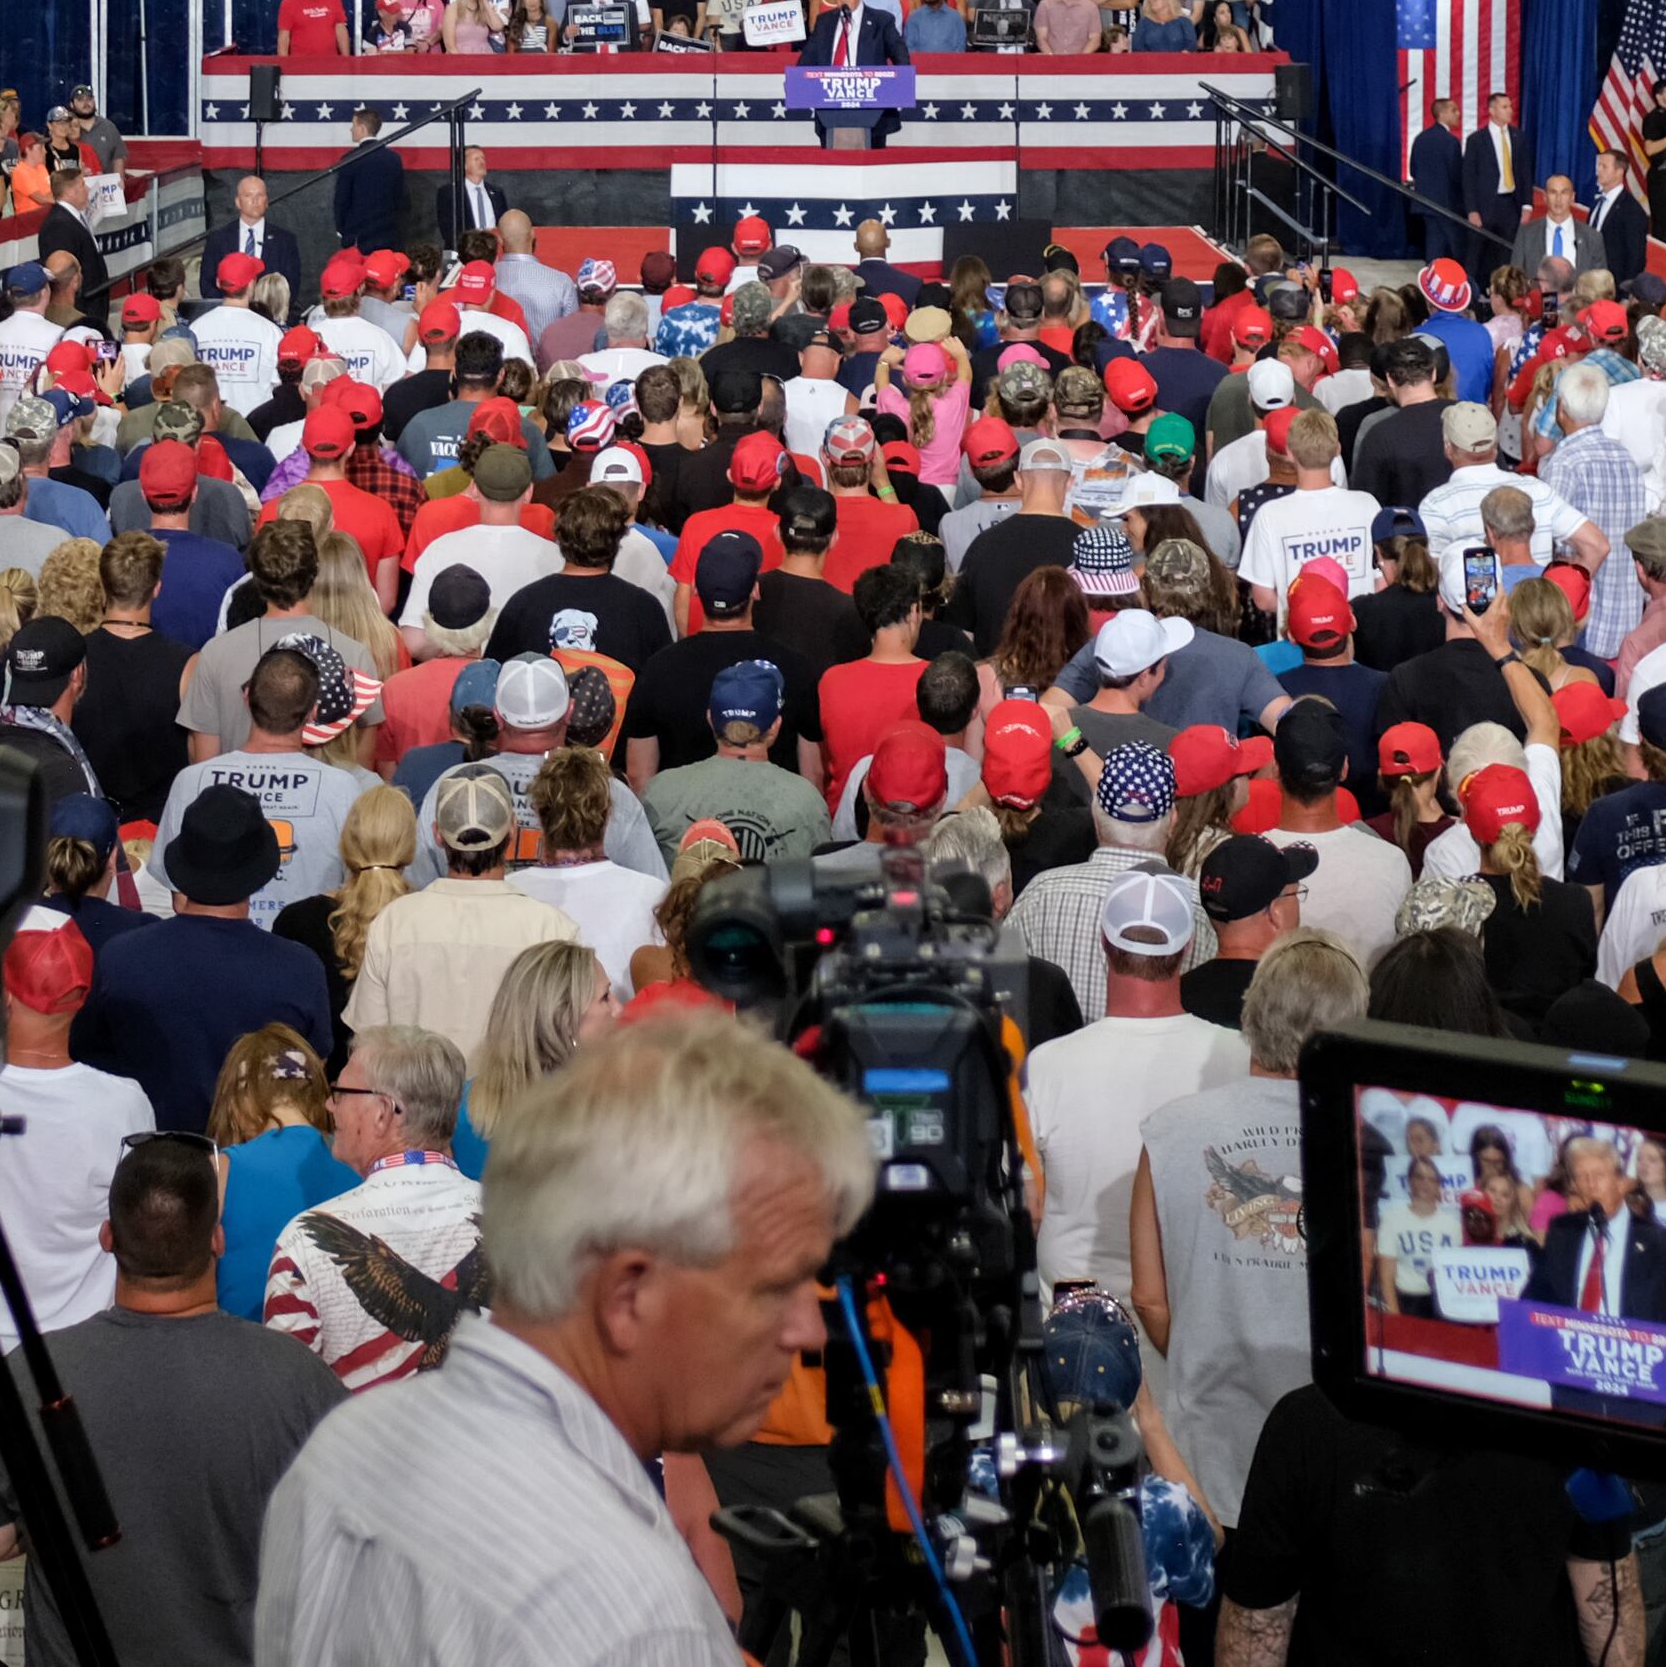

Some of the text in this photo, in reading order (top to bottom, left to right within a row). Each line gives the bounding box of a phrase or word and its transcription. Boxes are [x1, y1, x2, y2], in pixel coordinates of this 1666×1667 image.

[574, 14, 603, 25] BACK
[748, 9, 798, 25] TRUMP
[595, 24, 625, 35] BLUE
[754, 20, 794, 32] VANCE
[658, 40, 687, 54] BACK
[806, 71, 824, 79] TEXT
[824, 71, 864, 79] MINNESOTA
[819, 78, 883, 91] TRUMP
[826, 88, 876, 99] VANCE
[841, 101, 861, 109] 2024
[197, 347, 256, 364] TRUMP
[1287, 535, 1362, 561] TRUMP
[1310, 614, 1334, 625] TRUMP
[721, 708, 757, 719] TRUMP
[210, 769, 309, 792] TRUMP
[715, 807, 772, 826] ONE NATION
[1496, 803, 1526, 818] TRUMP
[1625, 812, 1640, 828] IF
[1616, 825, 1651, 845] THIS
[1242, 1125, 1280, 1138] WILD
[1221, 1136, 1279, 1155] HARLEY
[1397, 1229, 1453, 1257] USA
[1442, 1263, 1522, 1284] TRUMP
[1454, 1278, 1518, 1300] VANCE
[1533, 1312, 1563, 1327] TEXT
[1563, 1317, 1632, 1342] MINNESOTA
[1632, 1331, 1650, 1345] TO
[1558, 1330, 1665, 1366] TRUMP
[1570, 1354, 1653, 1382] VANCE
[1595, 1380, 1629, 1397] 2024
